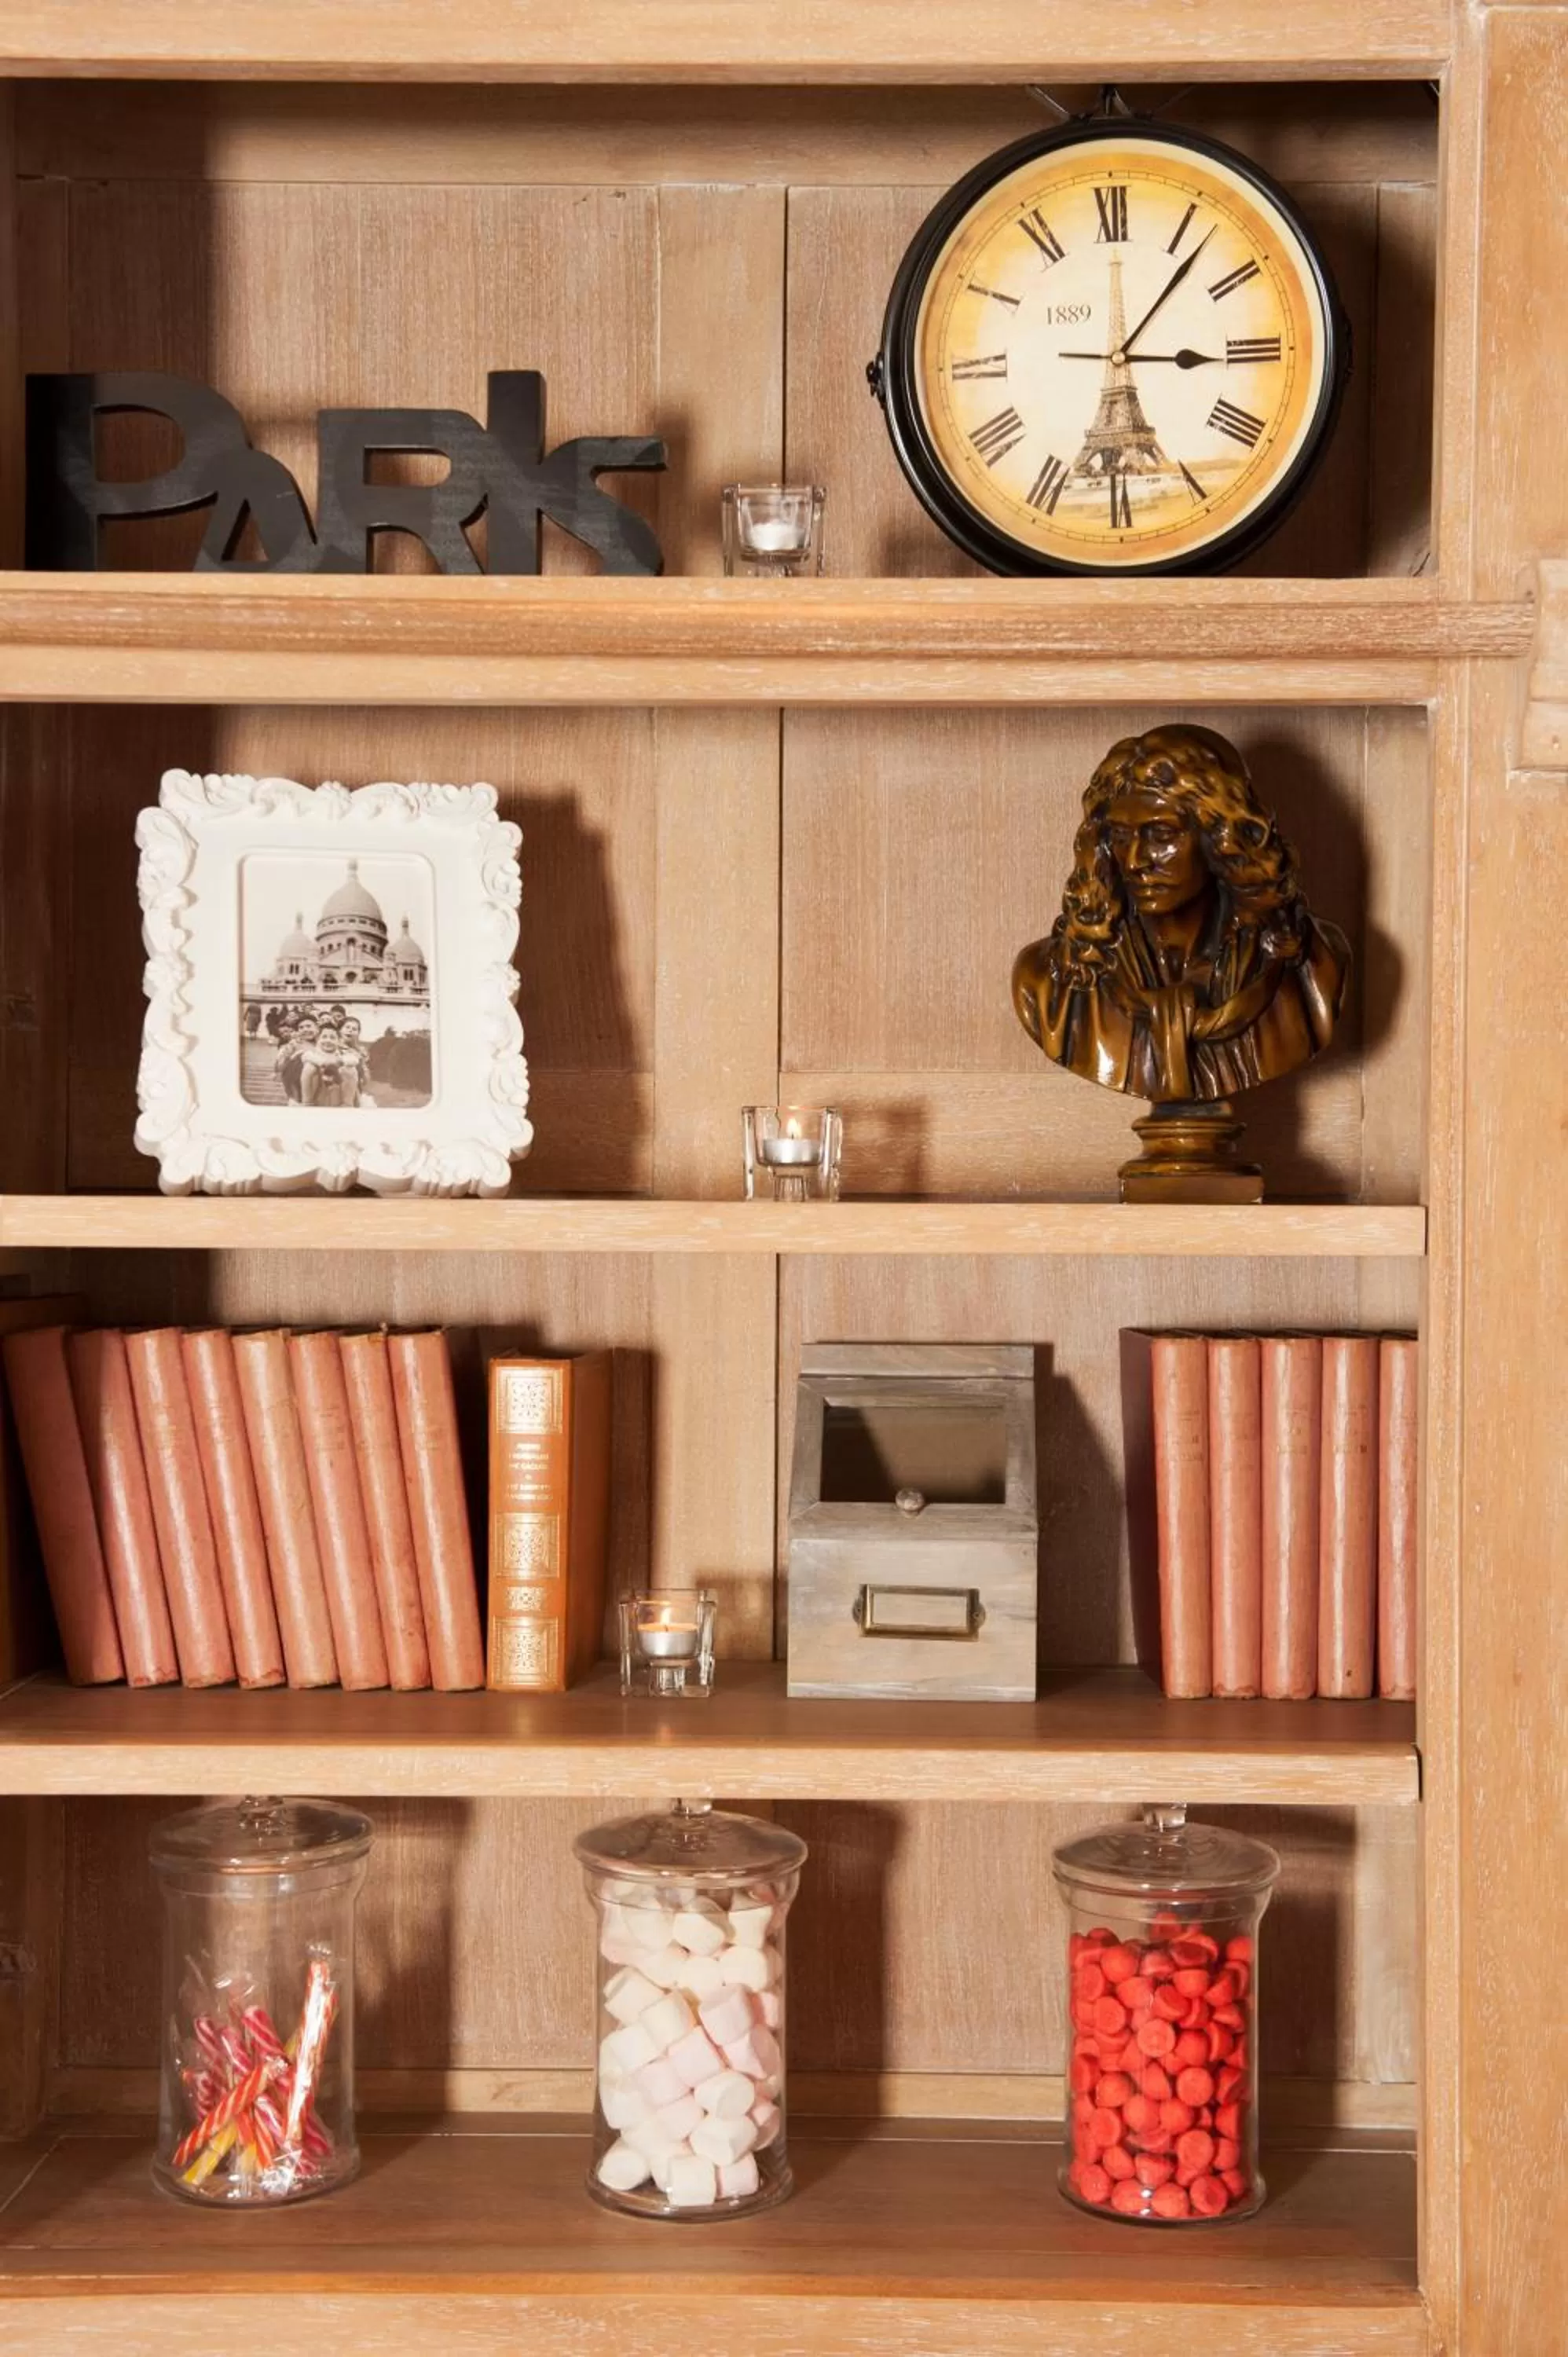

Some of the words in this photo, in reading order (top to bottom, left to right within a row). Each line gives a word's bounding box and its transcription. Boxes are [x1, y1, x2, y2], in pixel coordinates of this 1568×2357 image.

[1017, 207, 1069, 272] XI
[1090, 185, 1132, 243] XII
[1206, 255, 1263, 302] II
[1046, 304, 1092, 325] 1889
[1225, 334, 1281, 369] III
[1107, 473, 1134, 529] VI
